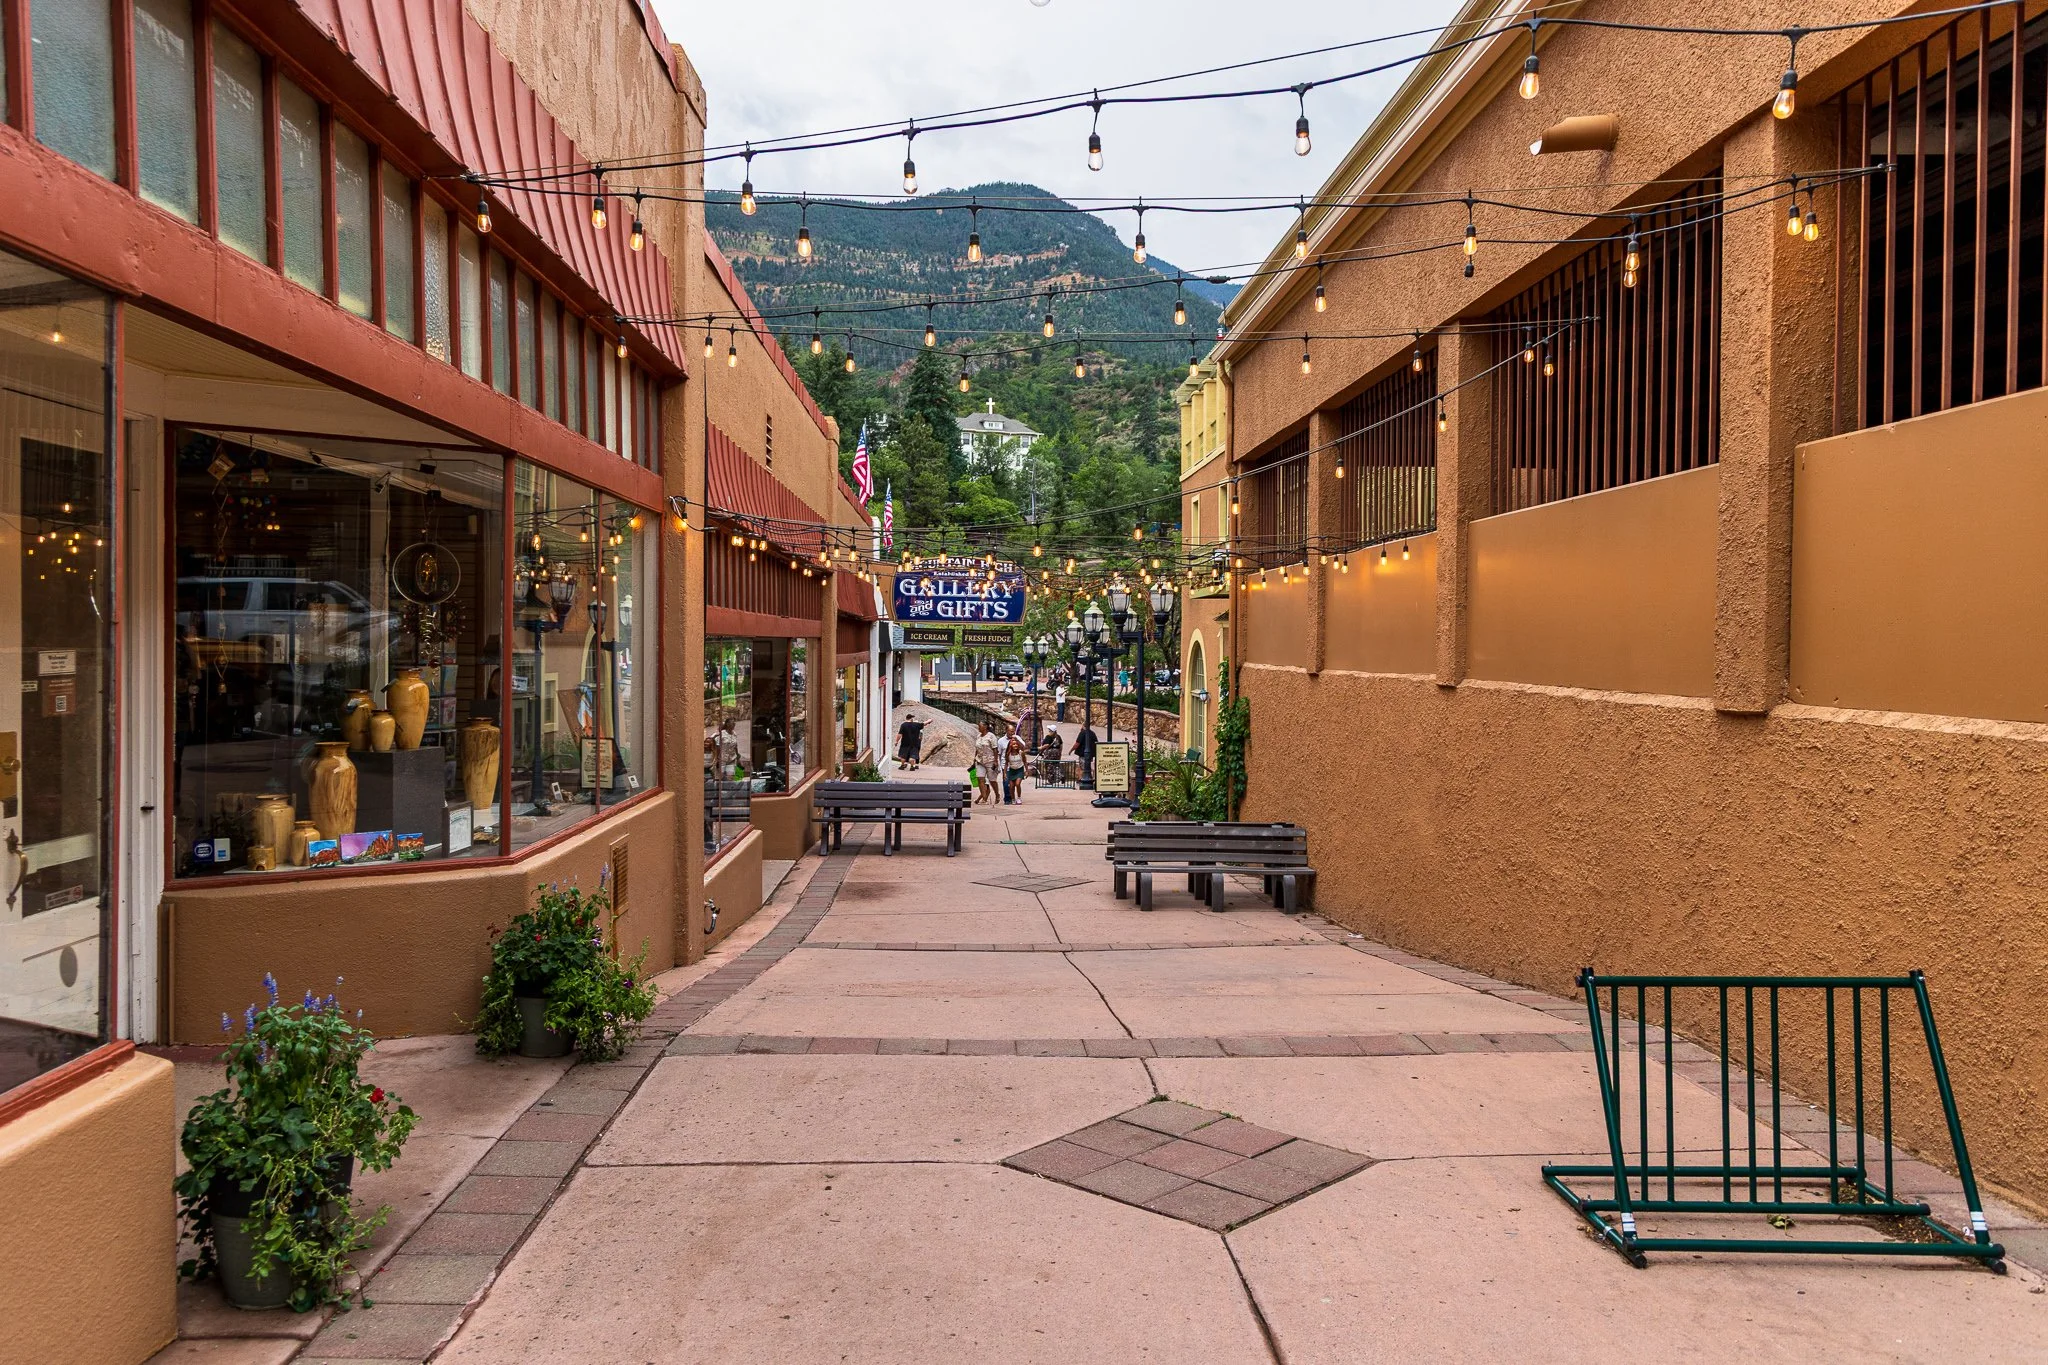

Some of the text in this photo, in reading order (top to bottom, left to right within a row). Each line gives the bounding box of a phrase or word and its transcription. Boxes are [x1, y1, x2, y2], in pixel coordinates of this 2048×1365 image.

[981, 560, 1013, 573] HGH
[900, 578, 1018, 599] GALLERY
[909, 600, 1009, 619] and GIFTS
[923, 633, 948, 641] CREAM
[988, 635, 1012, 643] FUDGE
